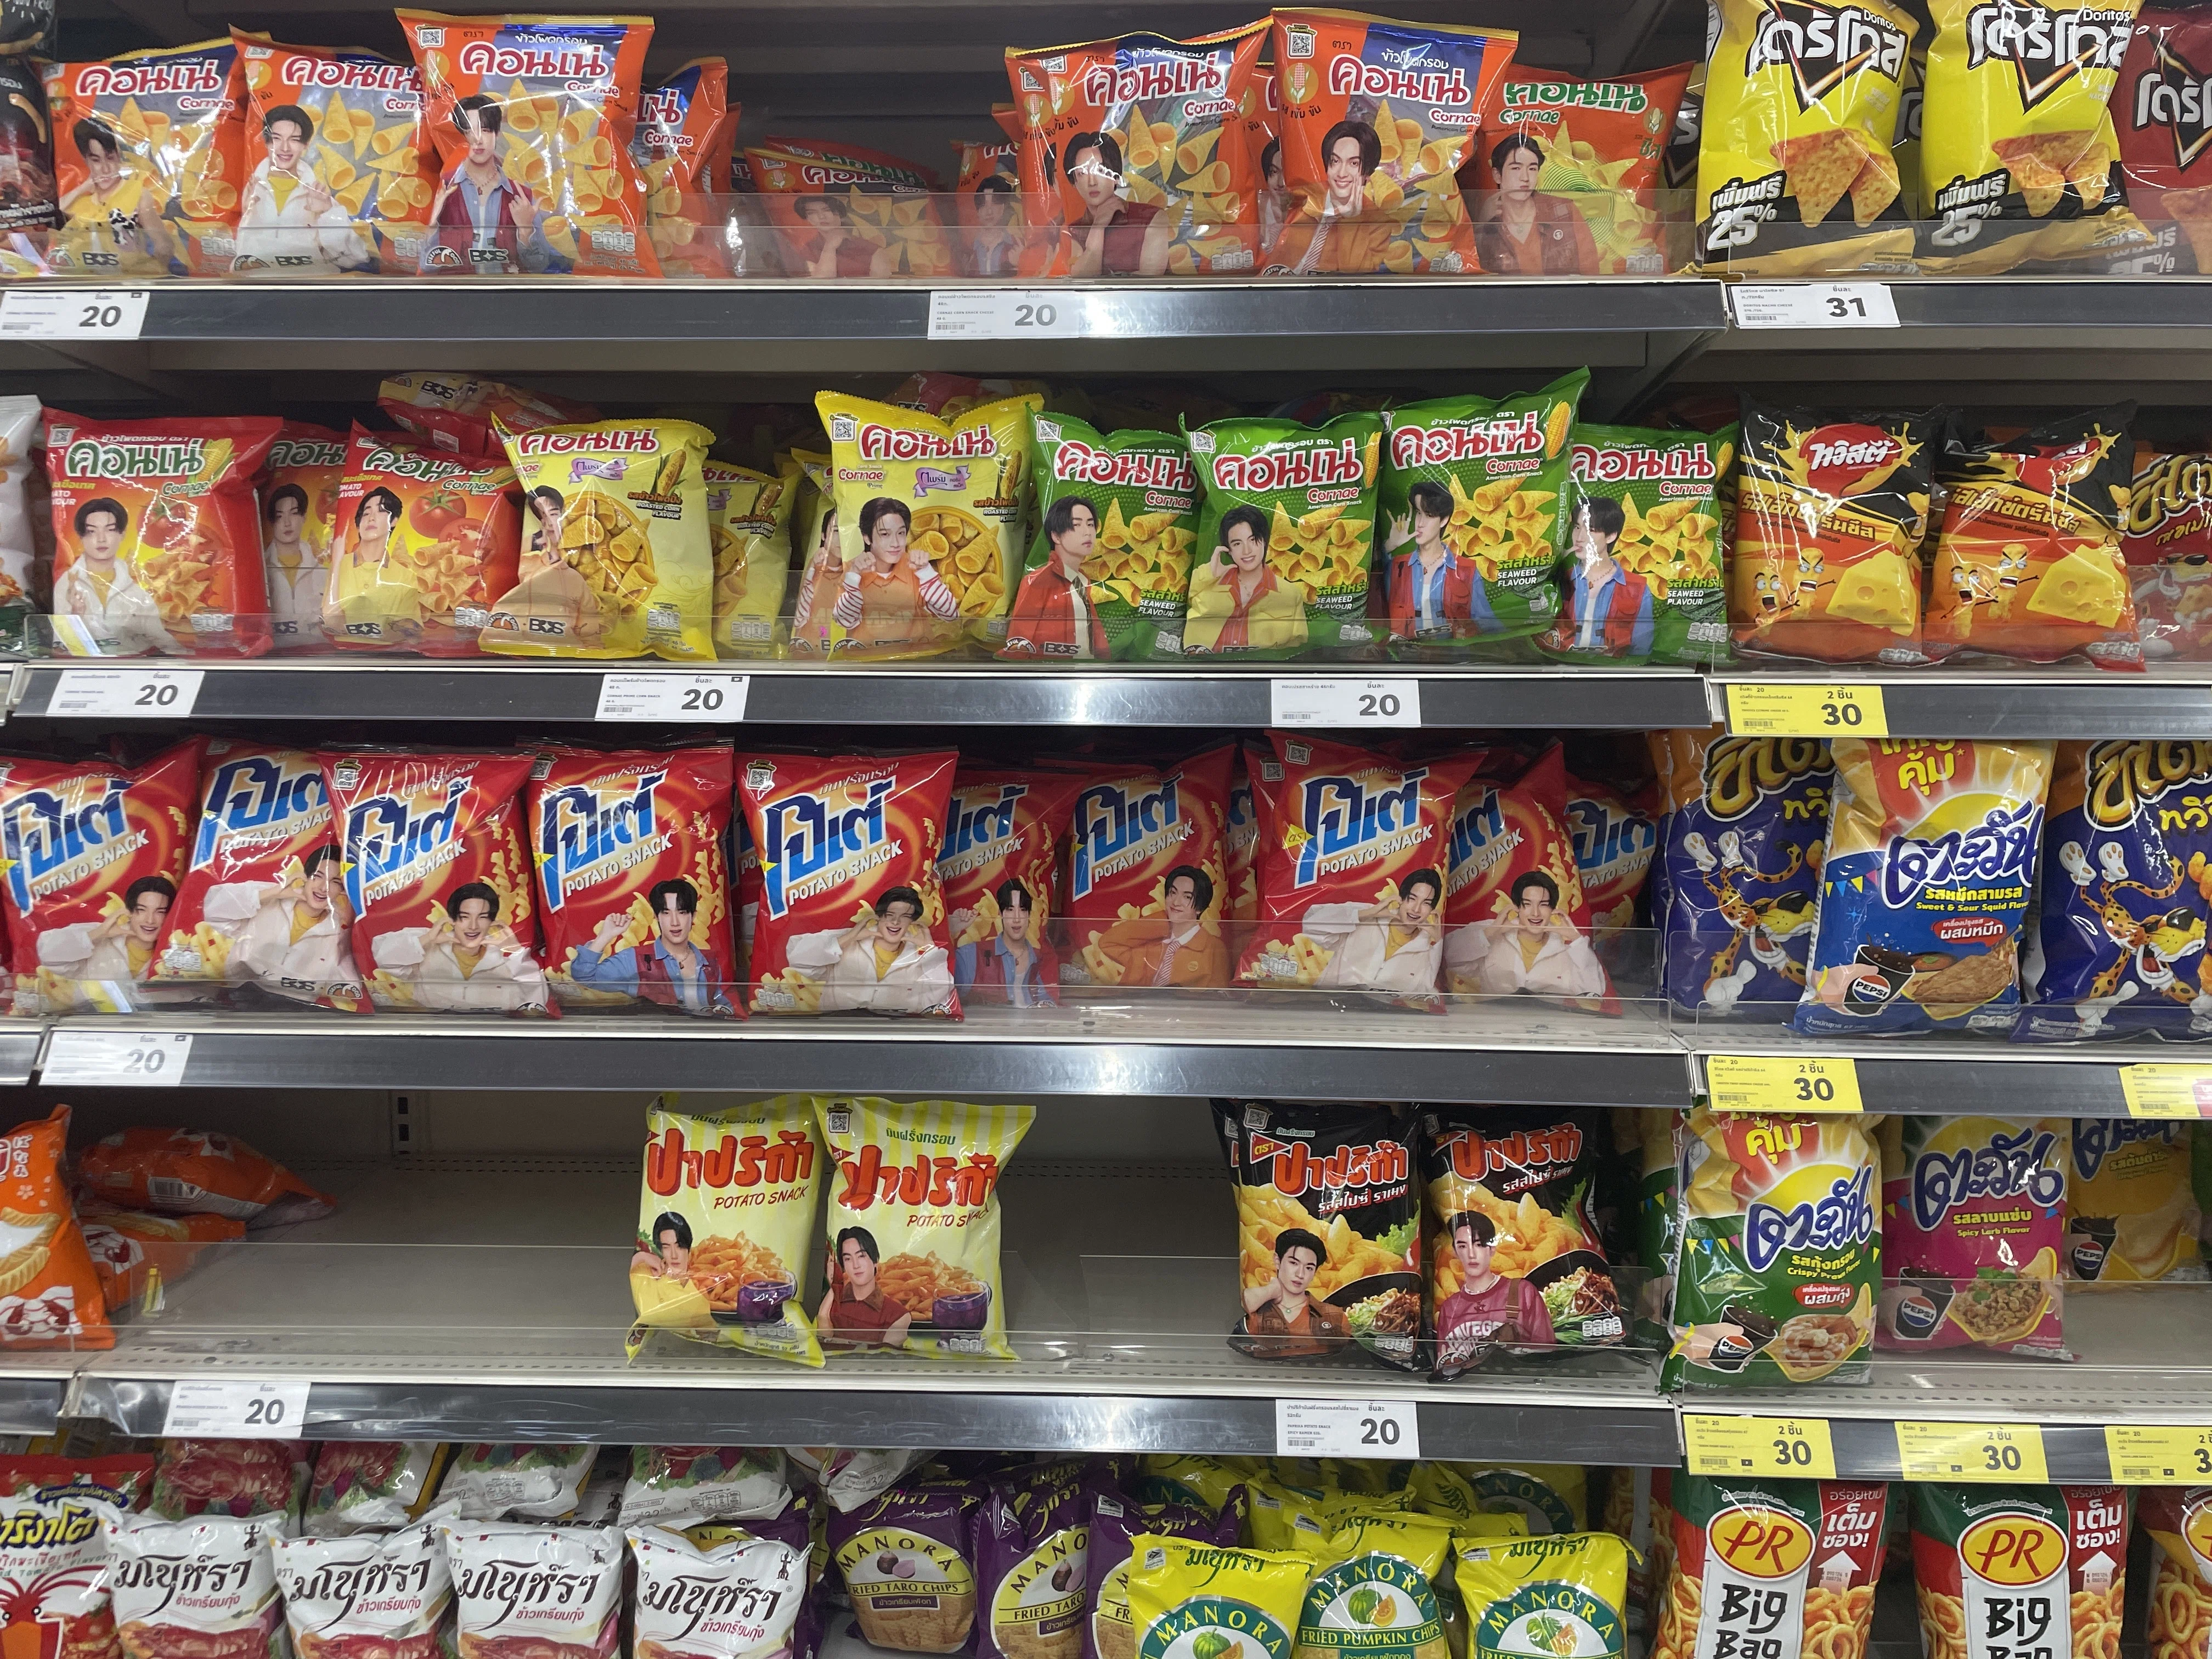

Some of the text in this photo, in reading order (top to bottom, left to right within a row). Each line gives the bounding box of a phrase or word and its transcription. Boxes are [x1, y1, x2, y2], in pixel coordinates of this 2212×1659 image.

[1863, 8, 1897, 31] Doritos
[2083, 8, 2131, 22] Doritos
[460, 41, 608, 77] คอนเน่
[76, 59, 221, 97] คอนเน่
[1085, 52, 1221, 106] คอนเน่
[1328, 54, 1471, 105] คอนเน่
[1429, 108, 1481, 126] Cornae
[1712, 173, 1782, 210] เพิ่มฟรี
[1937, 174, 2007, 211] เพิ่มฟรี
[78, 305, 122, 328] 20
[1015, 304, 1057, 326] 20
[1826, 297, 1866, 317] 31
[859, 423, 997, 460] คอนเน่
[1390, 410, 1545, 471] คอนเน่
[66, 438, 205, 478] คอนเน่
[1054, 440, 1197, 492] คอนเน่
[1213, 437, 1363, 492] คอนเน่
[1486, 458, 1540, 474] Cornae
[1572, 443, 1716, 483] คอนเน่
[1810, 439, 1894, 470] ทวิสตี้
[442, 479, 496, 492] Cornae
[838, 468, 884, 482] Cornae
[1146, 491, 1192, 509] Cornae
[1307, 488, 1359, 503] Cornae
[1659, 481, 1713, 495] Cornae
[636, 502, 682, 512] ROASTED CORN
[652, 511, 681, 520] FLAVOUR
[1497, 569, 1537, 579] SEAWEED
[1497, 577, 1537, 587] FLAVOUR
[1139, 599, 1176, 610] SEAWEED
[1316, 595, 1352, 605] SEAWEED
[1667, 590, 1704, 598] SEAWEED
[1138, 606, 1174, 618] FLAVOUR
[1315, 602, 1352, 611] FLAVOUR
[135, 684, 178, 706] 20
[681, 689, 724, 710] 20
[1359, 694, 1400, 716] 20
[1827, 687, 1853, 699] 2 ชิ้น
[1821, 703, 1862, 725] 30
[1898, 751, 1955, 796] คุ้ม
[1294, 766, 1430, 890] โปเต้
[537, 768, 668, 913] โปเต้
[759, 776, 897, 922] โปเต้
[974, 836, 1024, 867] SNACK
[1321, 824, 1433, 877] POTATO SNACK
[1479, 827, 1525, 872] SNACK
[33, 829, 149, 900] POTATO SNACK
[418, 838, 467, 879] SNACK
[565, 832, 673, 896] POTATO SNACK
[1094, 848, 1146, 883] POTATO
[1147, 823, 1194, 858] SNACK
[1882, 797, 2045, 909] ตะวัน
[789, 838, 905, 905] POTATO SNACK
[1916, 902, 1944, 911] Sweet
[1982, 902, 2007, 912] Squid
[1940, 923, 2004, 940] ผสมหมึก
[1855, 979, 1888, 998] PEPSI
[122, 1048, 166, 1074] 20
[1809, 1061, 1824, 1073] ชิ้น
[1794, 1077, 1833, 1101] 30
[885, 1127, 956, 1146] มันฝรั่งกรอบ
[1746, 1119, 1802, 1164] คุ้ม
[1254, 1143, 1274, 1155] ตรา
[1451, 1122, 1584, 1182] ปาปริก้า
[647, 1127, 814, 1196] ปาปริก้า
[1273, 1141, 1408, 1197] ปาปริก้า
[838, 1144, 999, 1211] ปาปริก้า
[1912, 1128, 2065, 1231] ตะวัน
[714, 1185, 809, 1210] POTATO SNACK
[906, 1211, 954, 1228] POTATO
[1743, 1164, 1873, 1273] ตะวัน
[1953, 1208, 2033, 1226] รสลาบแซ่บ
[1957, 1229, 1979, 1237] Spicy
[2002, 1226, 2030, 1234] Flavor
[1791, 1249, 1855, 1271] รสกุ้งกรอบ
[1787, 1267, 1846, 1280] Crispy Prawn
[1805, 1288, 1850, 1305] ผสมกุ้ง
[1903, 1302, 1934, 1319] PEPSI
[244, 1399, 285, 1425] 20
[1361, 1418, 1400, 1445] 20
[1779, 1426, 1785, 1435] 2
[1988, 1432, 1994, 1440] 2
[1773, 1440, 1811, 1465] 30
[1983, 1445, 2021, 1471] 30
[1827, 1503, 1877, 1532] เต็ม
[2077, 1498, 2122, 1531] เต็ม
[1723, 1520, 1793, 1572] PR
[1822, 1533, 1869, 1549] ซอง!
[2076, 1528, 2120, 1549] ซอง!
[840, 1536, 953, 1572] MANORA
[1976, 1530, 2042, 1577] PR
[885, 1582, 959, 1593] TARO CHIPS
[1311, 1562, 1426, 1611] MANORA
[176, 1594, 240, 1608] ข้าวเกรียบกุ้ง
[356, 1598, 421, 1615] ข้าวเกรียบกุ้ง
[1014, 1605, 1048, 1620] FRIED
[1719, 1584, 1786, 1634] Big
[516, 1607, 585, 1622] ข้าวเกรียบกุ้ง
[1489, 1590, 1616, 1641] MANORA
[1984, 1598, 2051, 1643] Big
[699, 1618, 765, 1642] ข้าวเกรียบกุ้ง
[1156, 1605, 1282, 1651] MANORA
[1302, 1624, 1441, 1646] FRIED PUMPKIN CHIPS
